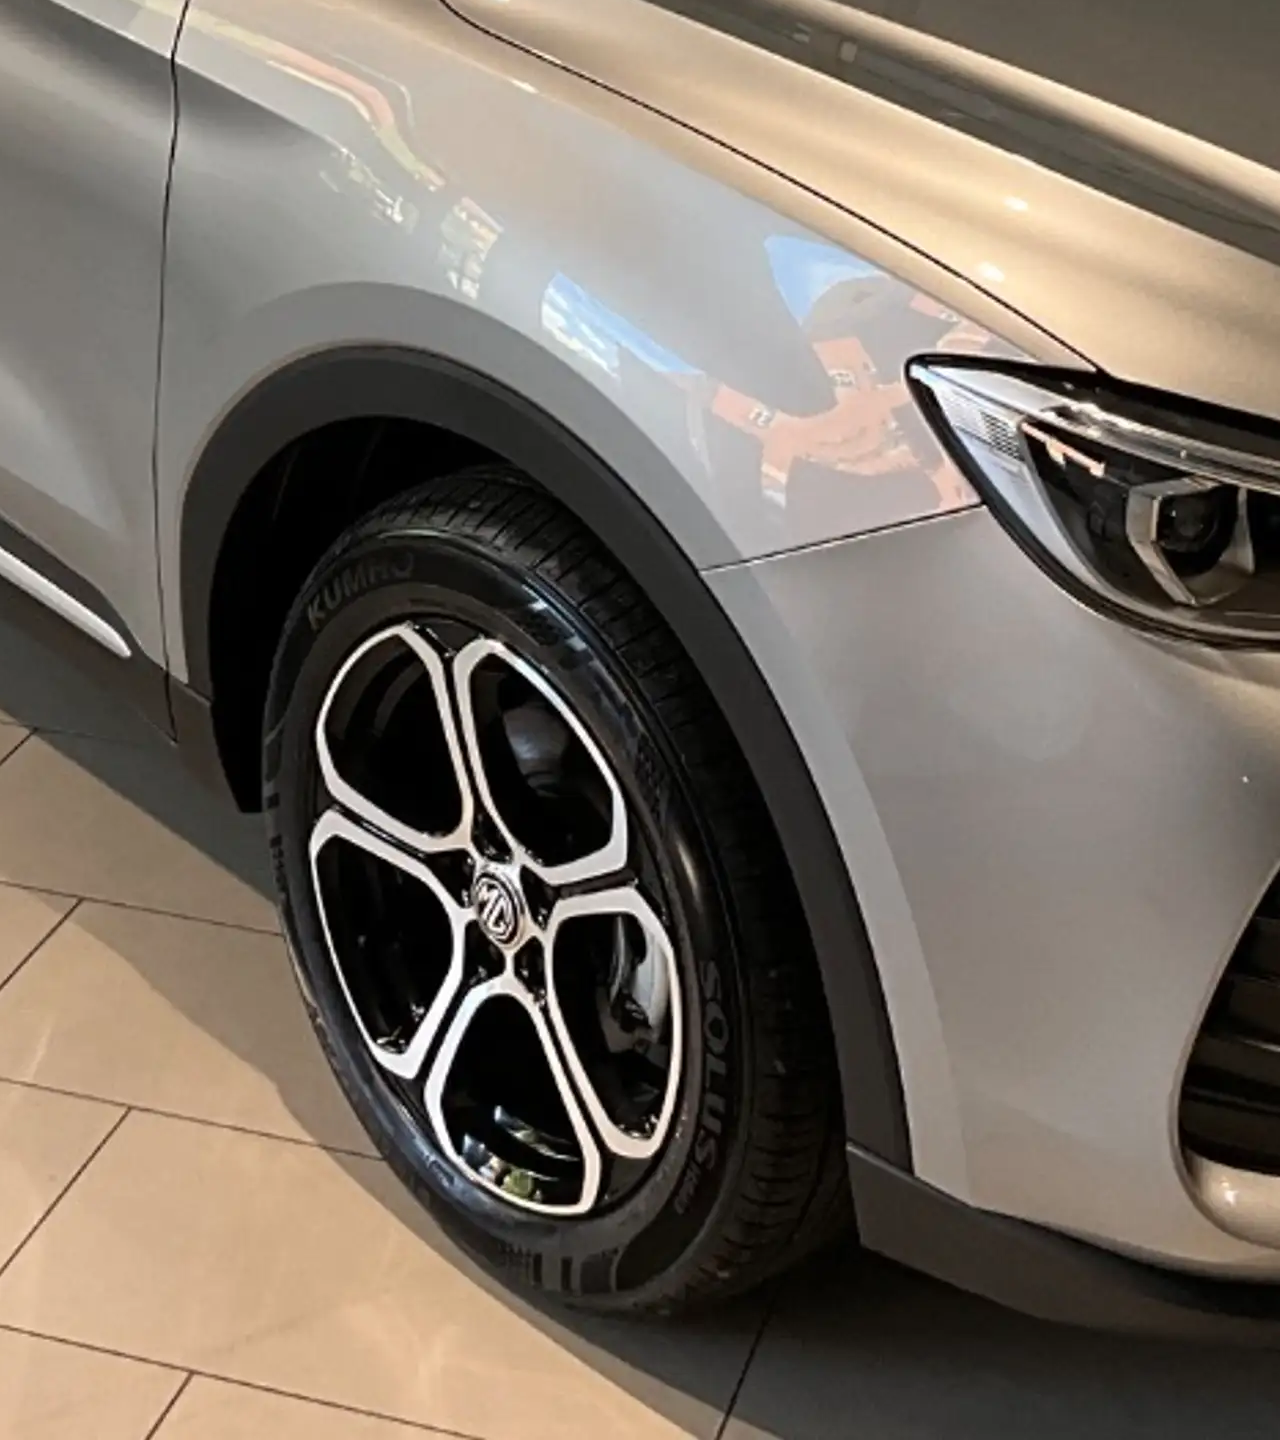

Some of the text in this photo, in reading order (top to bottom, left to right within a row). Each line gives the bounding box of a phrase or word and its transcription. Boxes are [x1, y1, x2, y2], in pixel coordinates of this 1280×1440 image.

[306, 549, 416, 632] KUMHO
[477, 880, 516, 940] MG
[694, 957, 731, 1172] SOLUS
